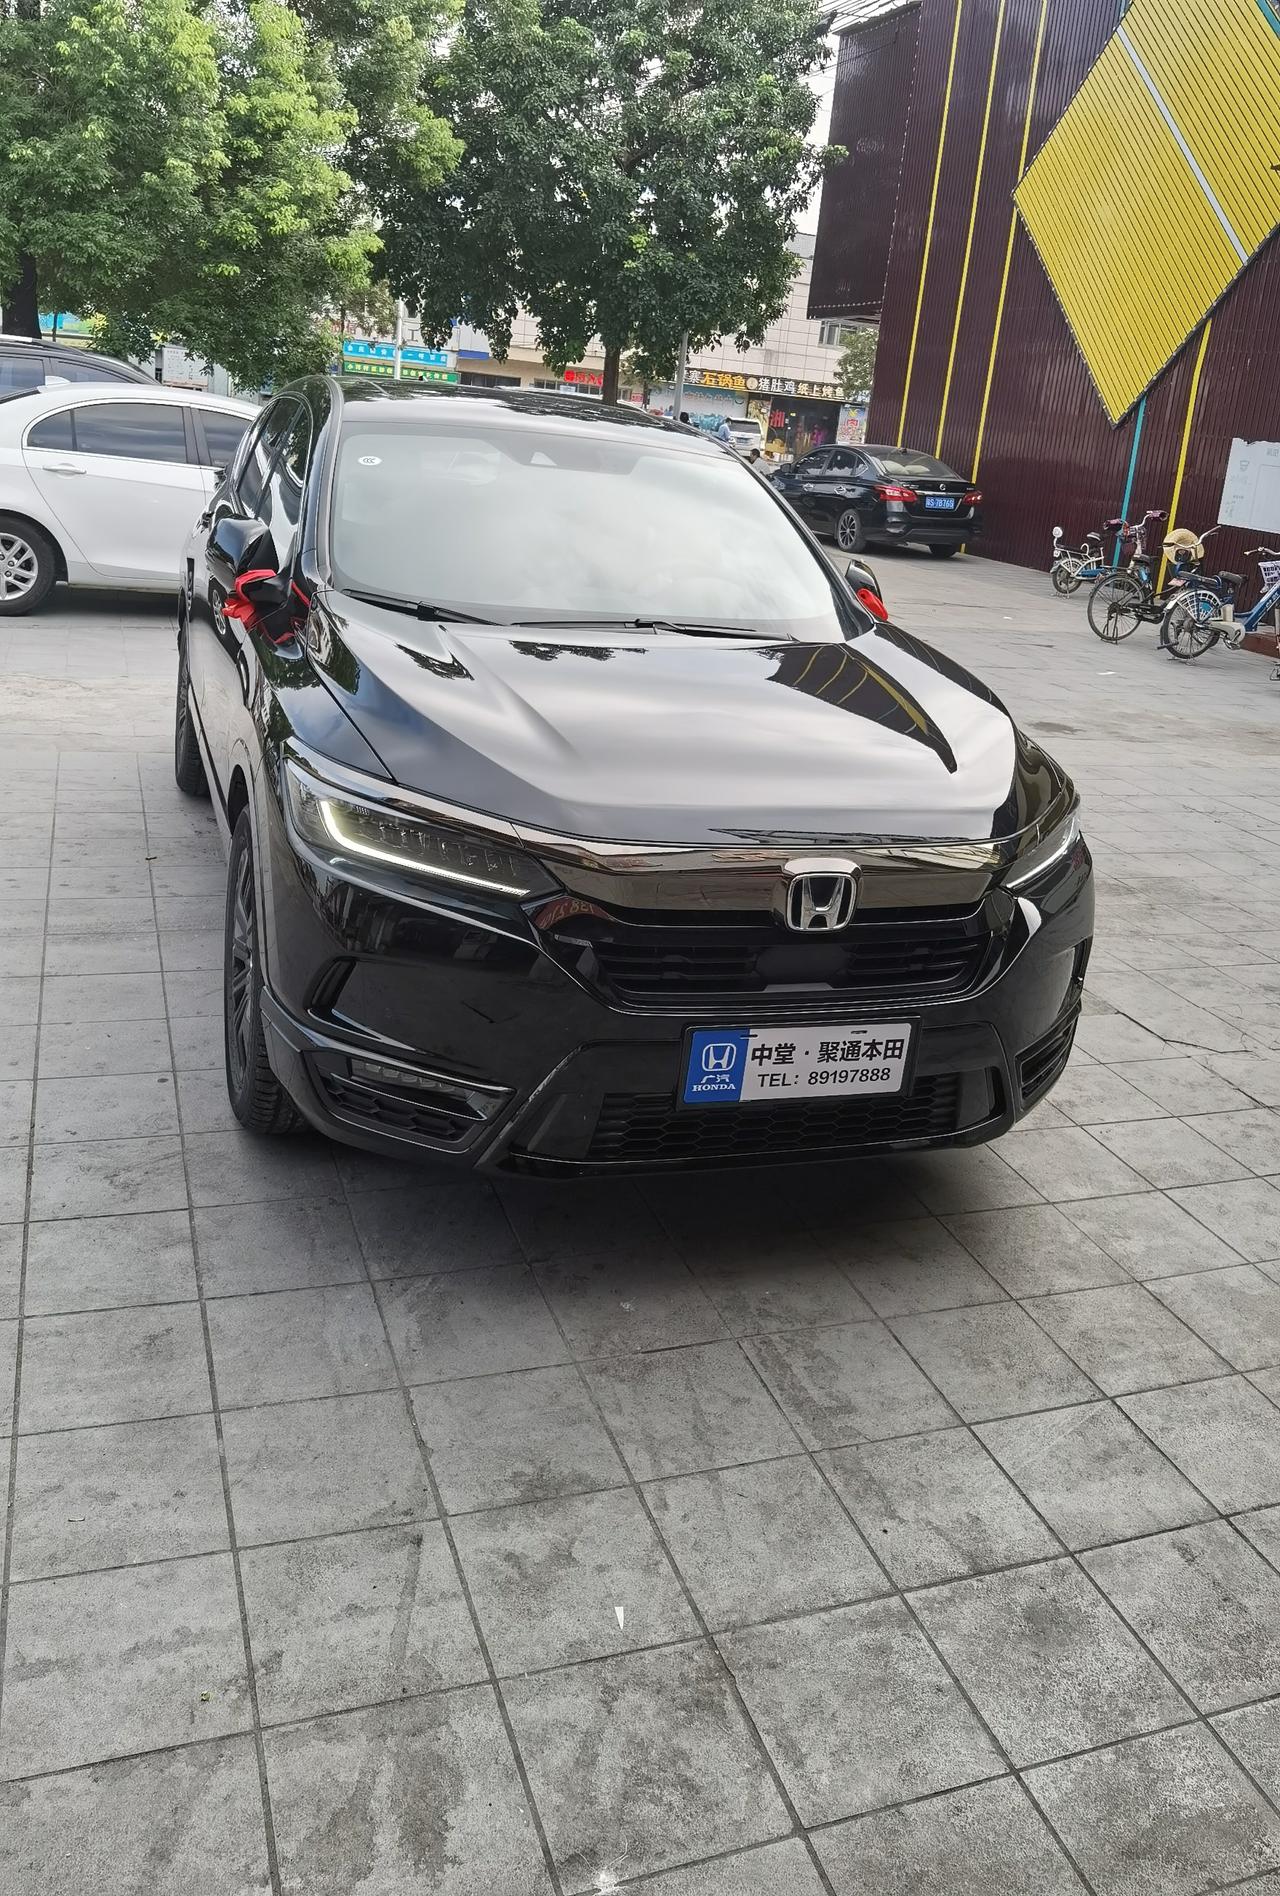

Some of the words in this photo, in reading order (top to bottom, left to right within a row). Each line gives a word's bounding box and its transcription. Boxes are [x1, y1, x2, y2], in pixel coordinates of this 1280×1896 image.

[700, 1074, 730, 1083] 广汽
[807, 1067, 891, 1085] 89197888
[691, 1082, 736, 1092] HONDA
